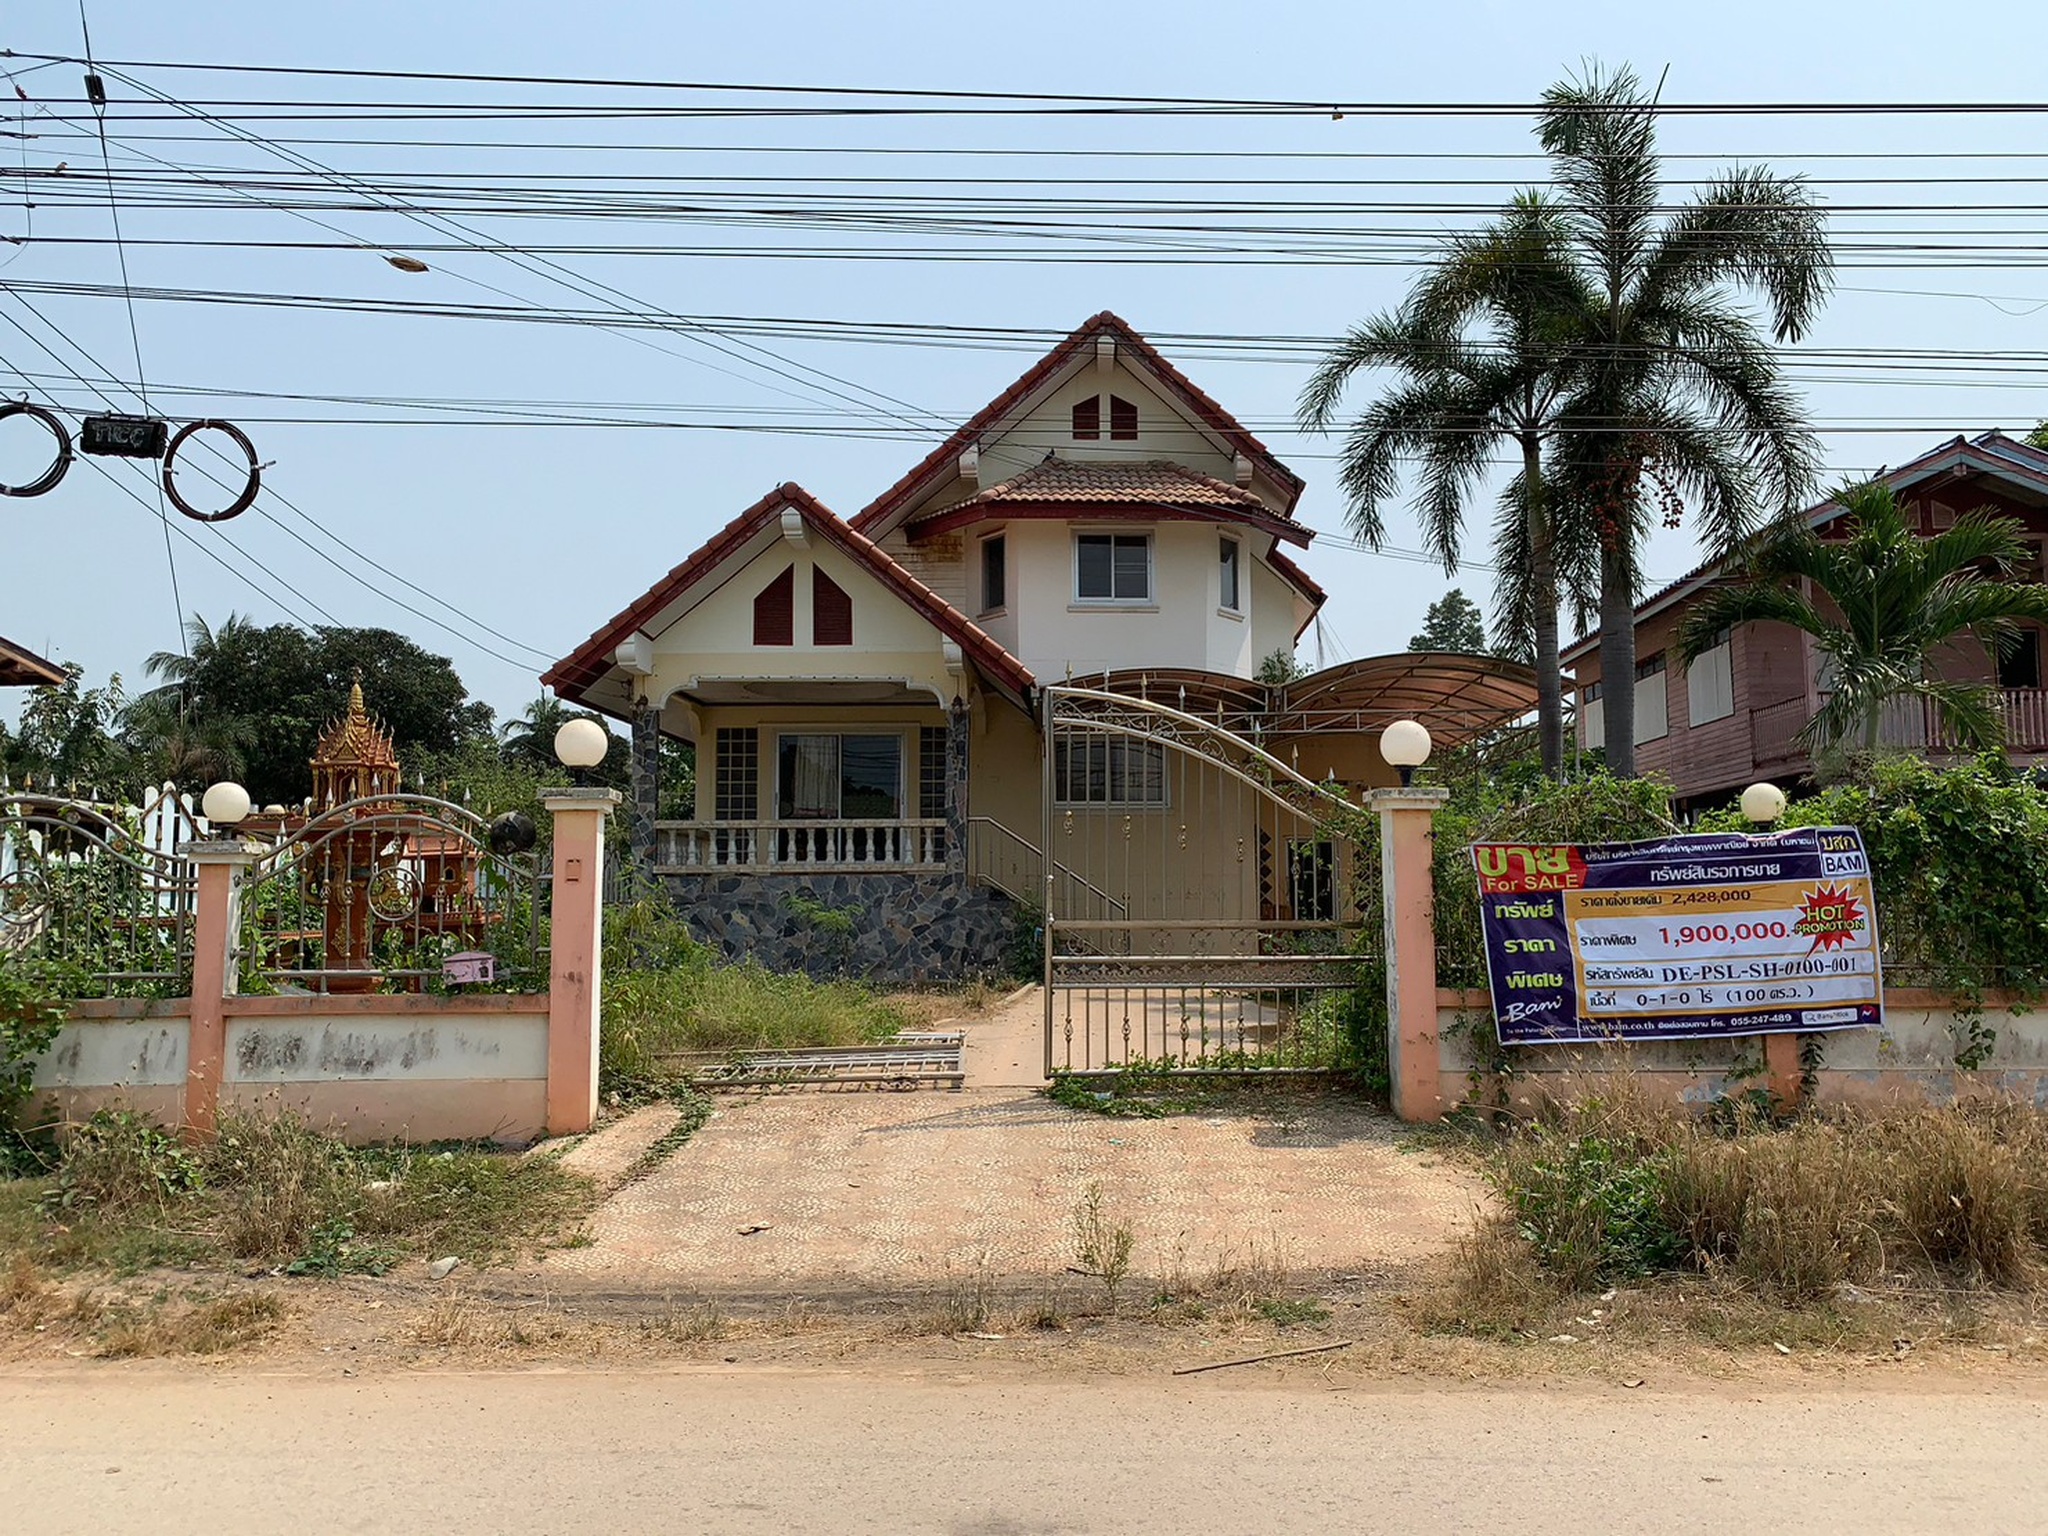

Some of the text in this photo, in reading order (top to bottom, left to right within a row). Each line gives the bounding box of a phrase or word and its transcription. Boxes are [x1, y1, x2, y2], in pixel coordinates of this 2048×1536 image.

[1819, 834, 1857, 852] บสก
[1476, 846, 1570, 877] ขาย
[1826, 854, 1862, 873] BAM
[1650, 862, 1781, 882] ทรัพย์สินรอการขาย
[1485, 874, 1579, 891] For SALE
[1672, 889, 1751, 906] 2,428,000
[1494, 898, 1555, 919] ทรัพย์
[1806, 904, 1845, 921] HOT
[1794, 918, 1865, 935] PROMOTION
[1503, 938, 1556, 953] ราคา
[1580, 934, 1637, 947] ราคาพิเศษ
[1505, 970, 1564, 990] พิเศษ
[1586, 966, 1654, 981] รหัสทรัพย์สิน
[1588, 991, 1617, 1007] เนื้อที่
[1636, 991, 1690, 1007] 0-1-0
[1699, 987, 1713, 1003] ไร่
